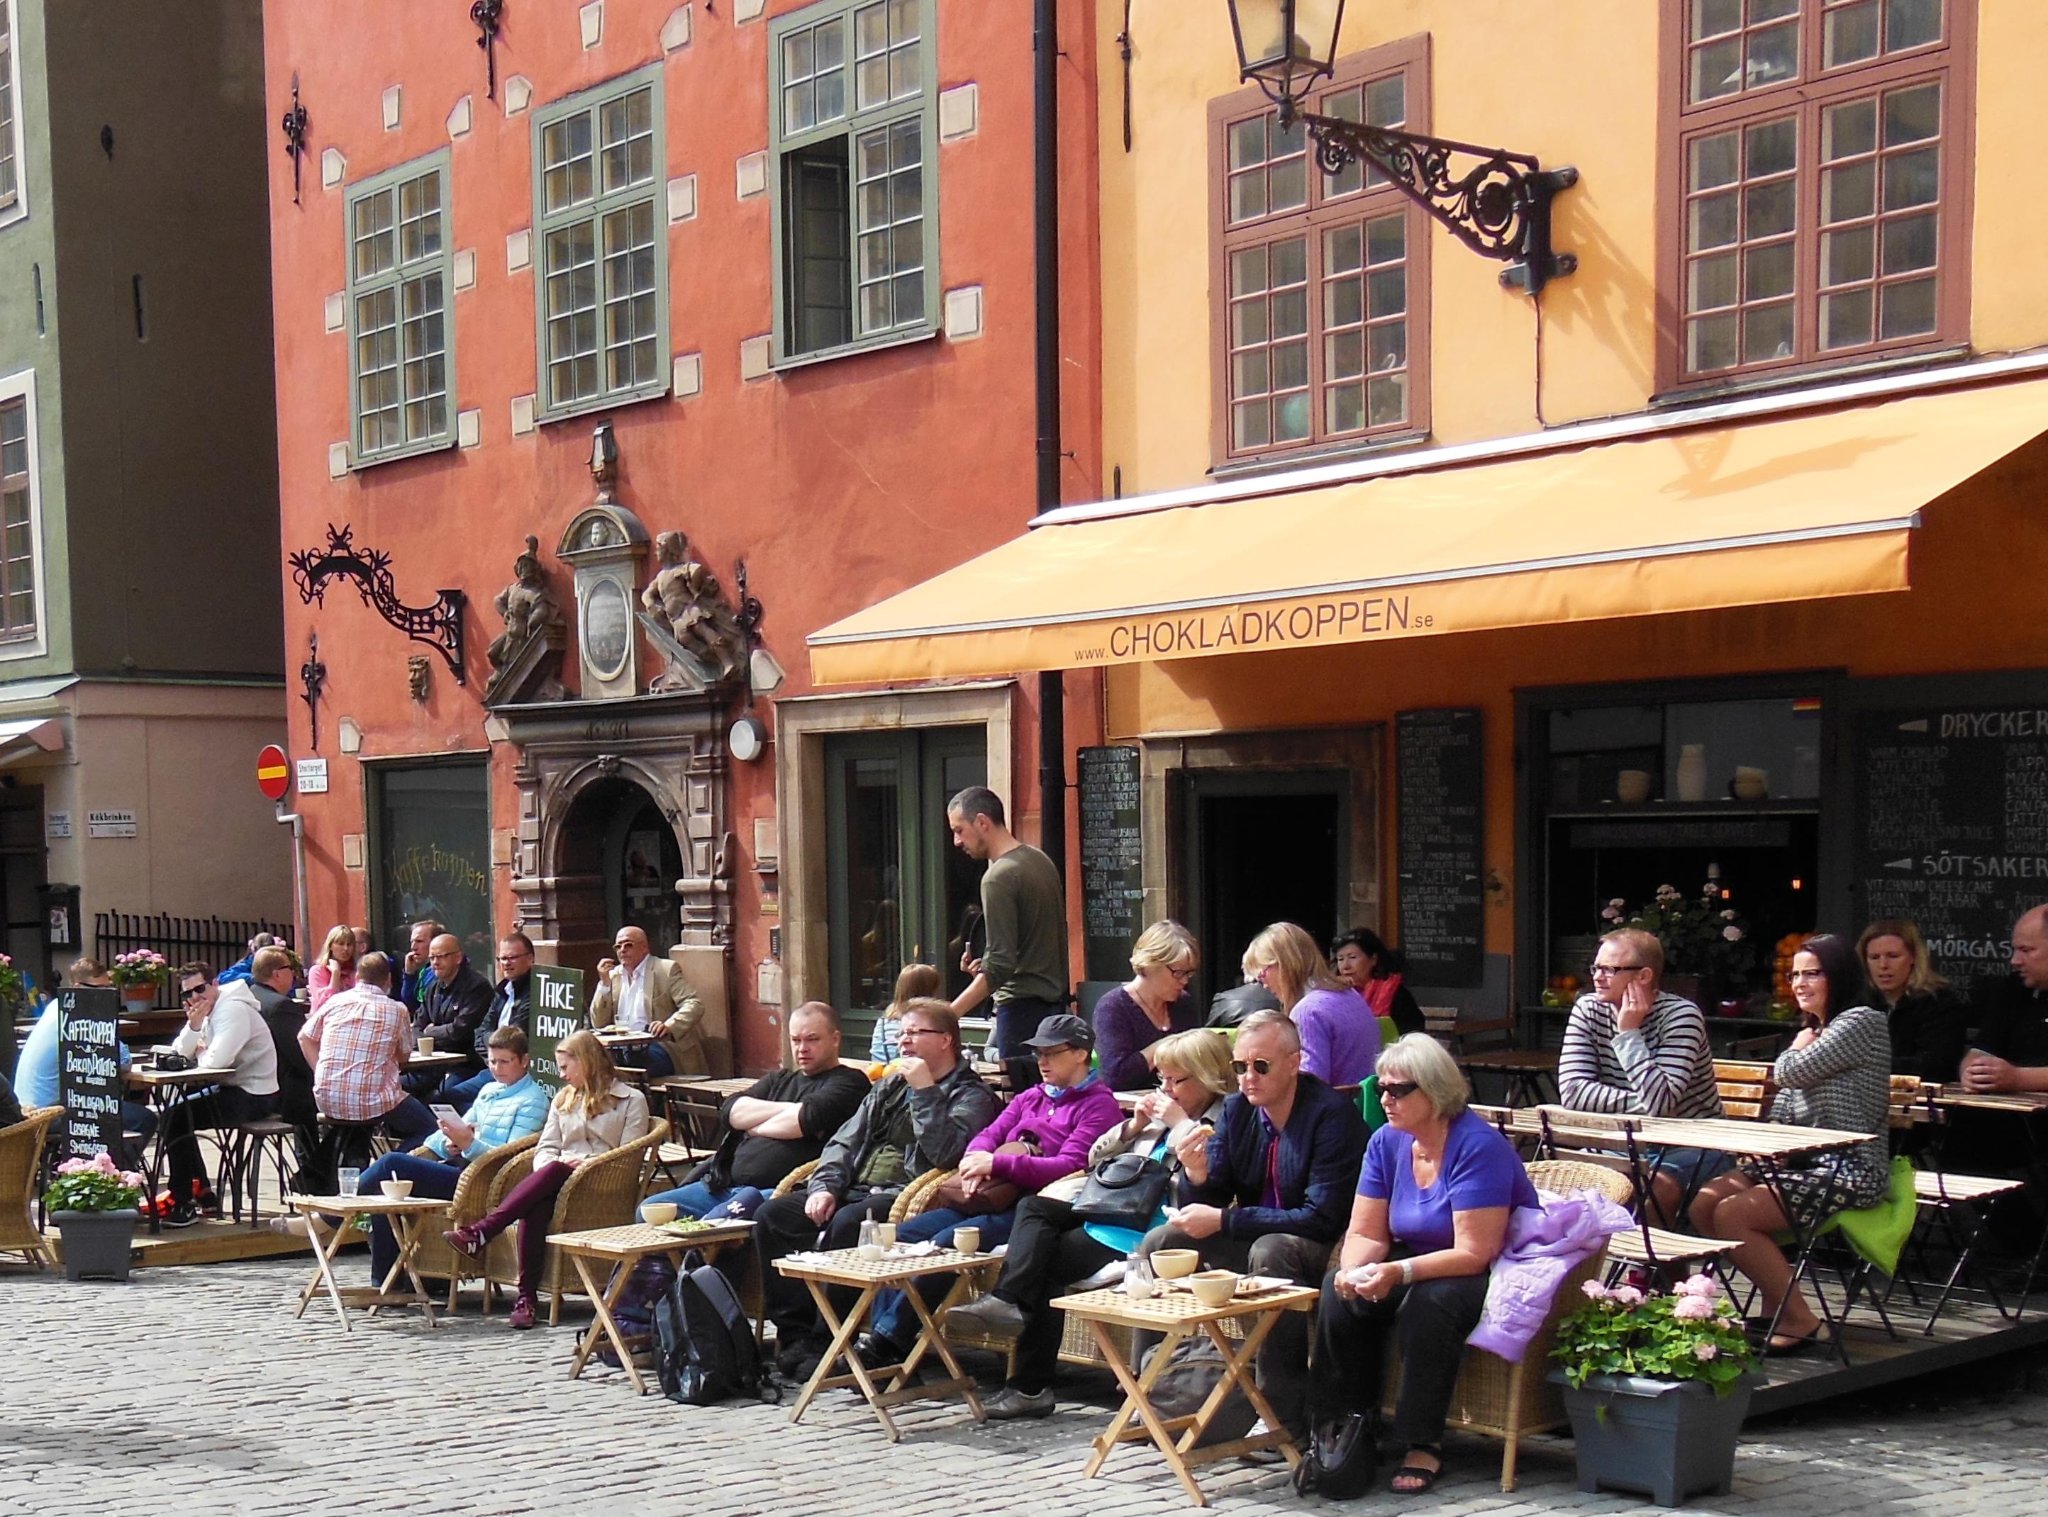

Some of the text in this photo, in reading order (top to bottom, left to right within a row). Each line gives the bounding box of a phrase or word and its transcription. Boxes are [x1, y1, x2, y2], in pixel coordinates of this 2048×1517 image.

[1941, 710, 2048, 737] DRYCKER
[1922, 850, 2048, 878] SÖTSAKER
[1925, 933, 2013, 959] MÖRGÅS
[536, 973, 575, 1010] TAKE
[536, 1014, 578, 1038] AWAY
[537, 1057, 560, 1076] DRIN
